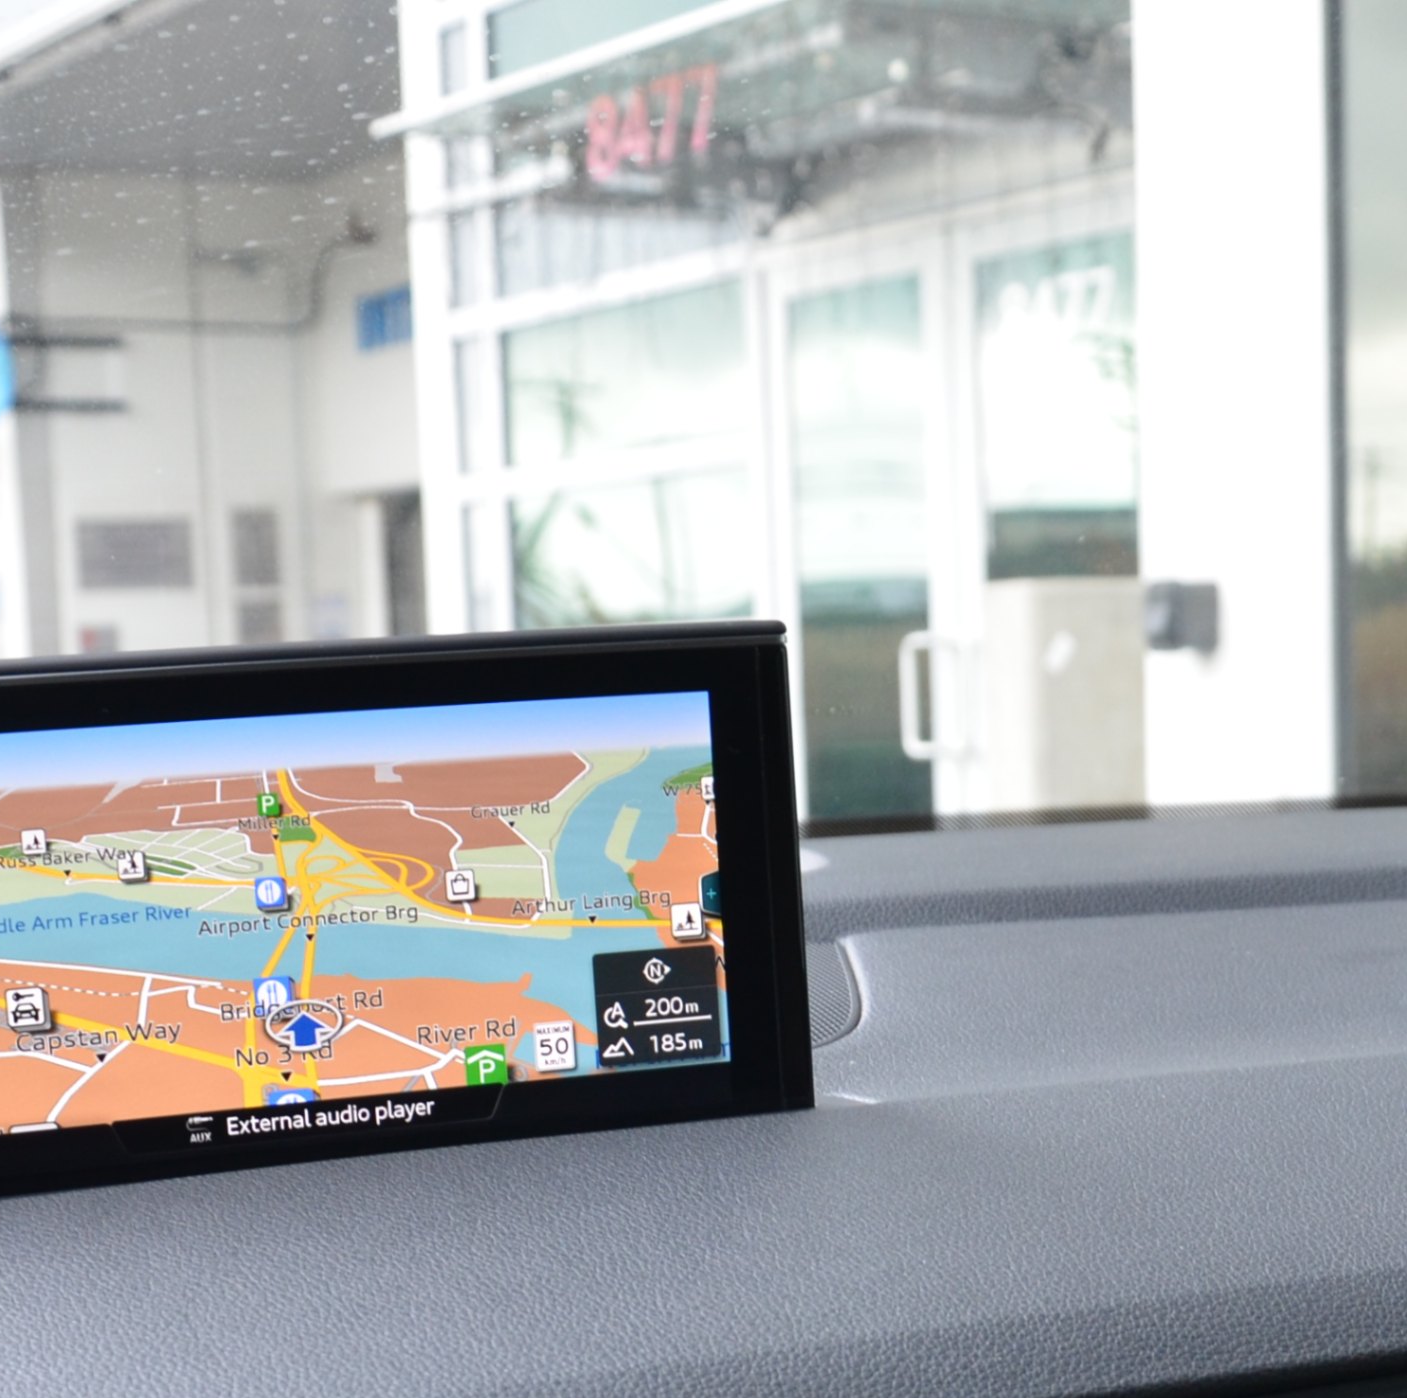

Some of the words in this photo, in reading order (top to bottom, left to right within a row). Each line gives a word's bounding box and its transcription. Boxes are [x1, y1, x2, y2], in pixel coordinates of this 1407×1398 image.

[261, 795, 275, 814] P
[471, 804, 525, 819] Grauer
[530, 801, 551, 815] Rd
[238, 815, 284, 830] Miller
[291, 813, 311, 828] Rd
[42, 851, 92, 866] Baker
[96, 846, 137, 863] Way
[511, 897, 576, 915] Arthur
[583, 894, 633, 912] Laing
[639, 890, 671, 908] Brg
[32, 914, 73, 931] Arm
[79, 909, 139, 927] Fraser
[145, 904, 192, 921] River
[198, 916, 271, 940] Airport
[277, 908, 378, 929] Connector
[385, 905, 419, 922] Brg
[354, 989, 383, 1009] Rd
[16, 1029, 118, 1055] Capstan
[125, 1022, 181, 1044] Way
[417, 1025, 477, 1044] River
[486, 1017, 516, 1039] Rd
[236, 1048, 269, 1067] No
[277, 1044, 292, 1063] 3
[539, 1037, 569, 1056] 50
[478, 1058, 496, 1084] P
[544, 1057, 567, 1066] km/h
[226, 1109, 312, 1136] External
[315, 1105, 370, 1127] audio
[375, 1100, 435, 1126] player
[190, 1132, 212, 1143] AUX
